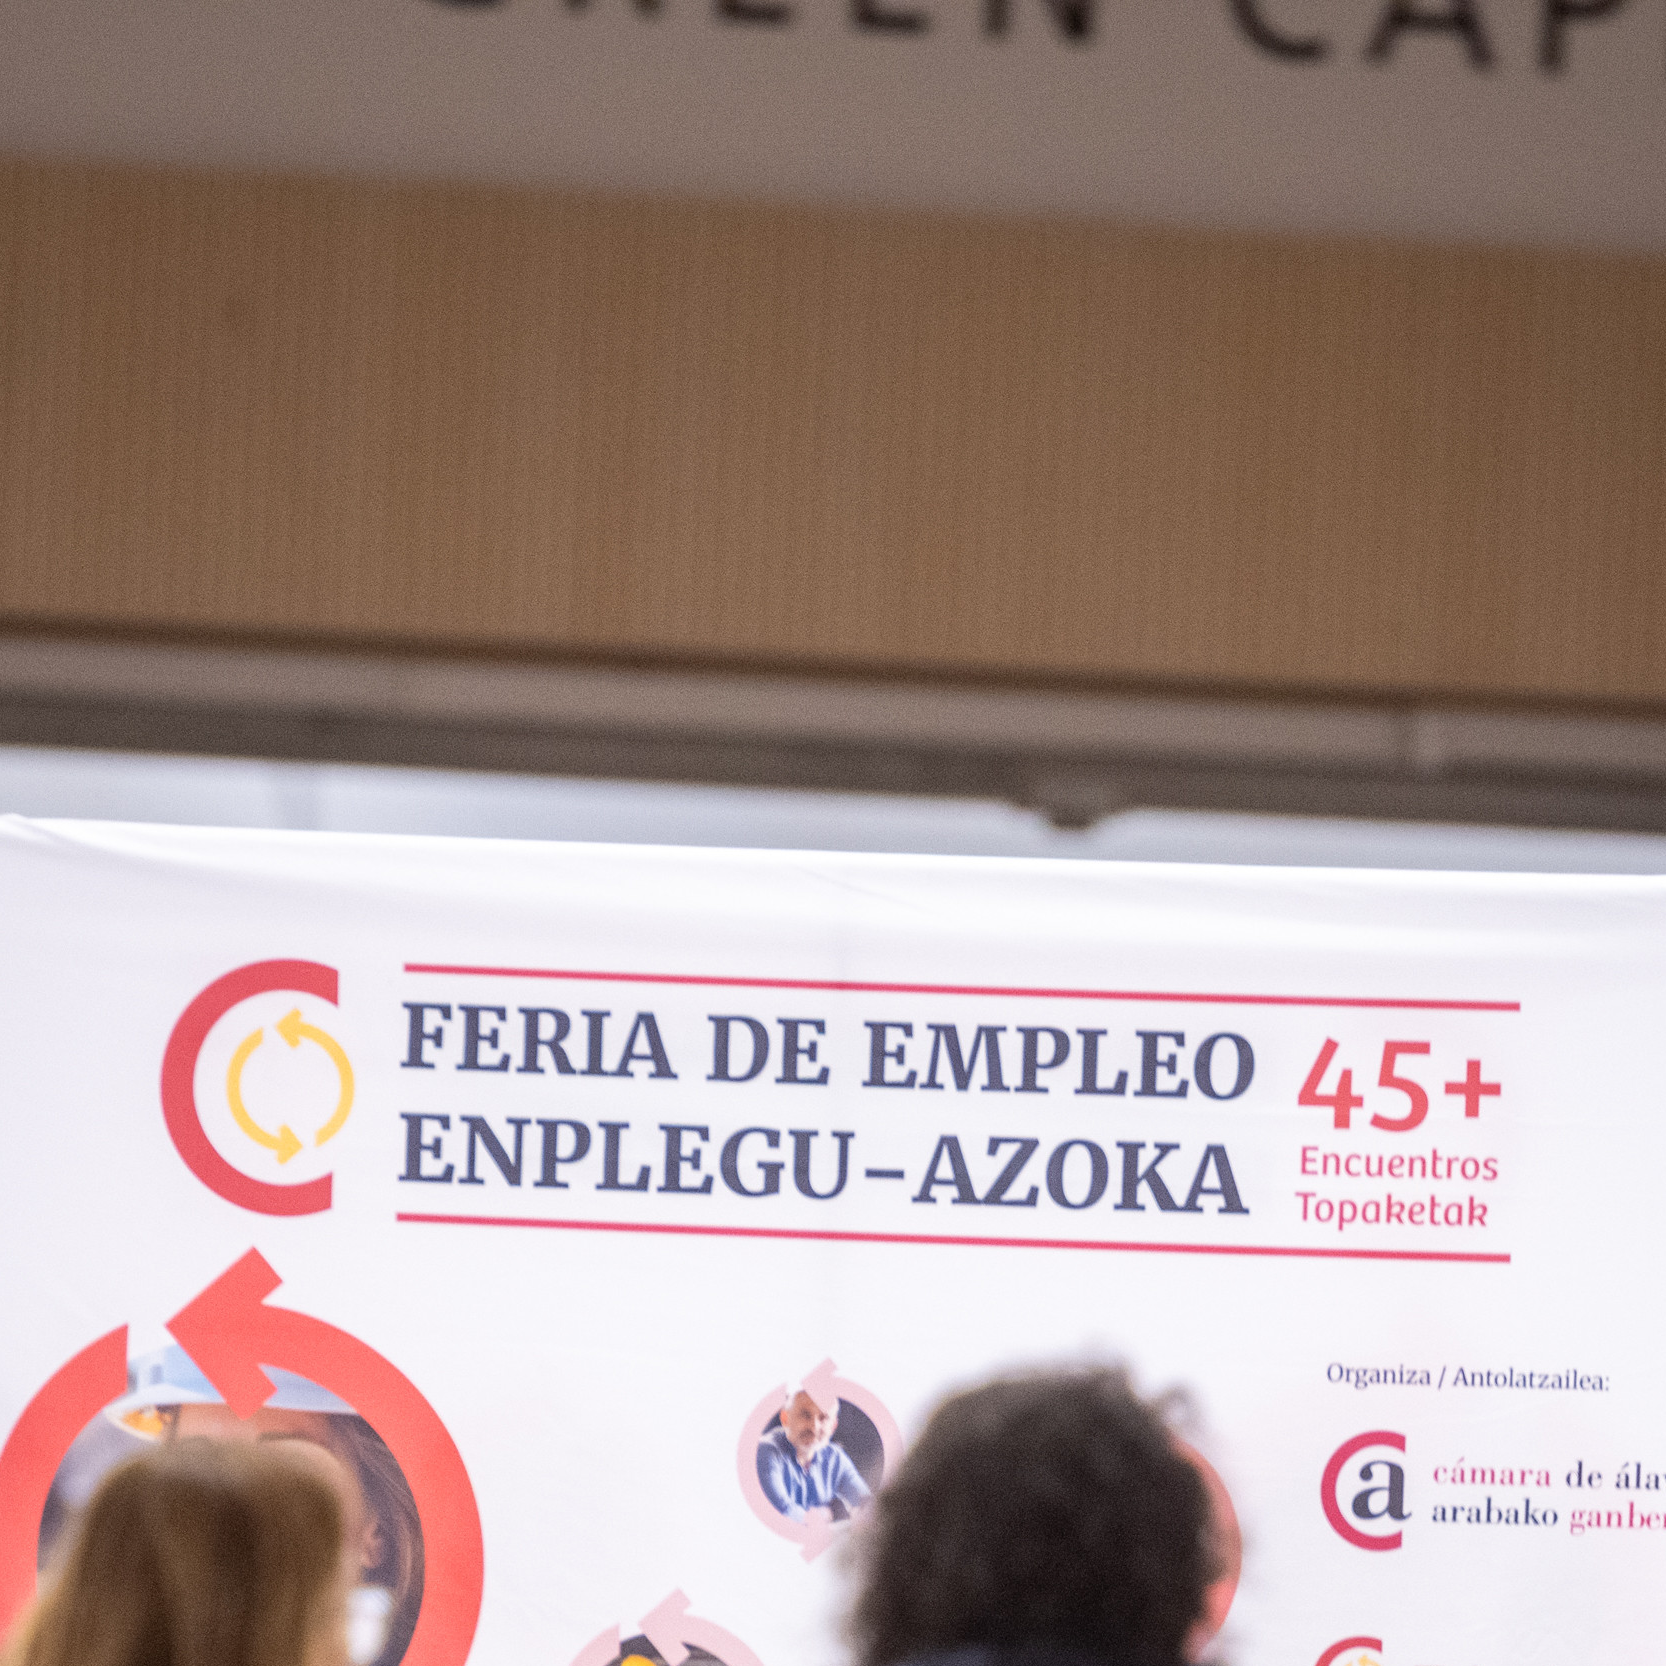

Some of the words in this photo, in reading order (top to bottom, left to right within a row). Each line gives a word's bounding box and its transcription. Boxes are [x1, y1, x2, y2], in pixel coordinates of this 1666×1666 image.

[399, 1001, 679, 1081] FERIA
[706, 1014, 831, 1087] DE
[861, 1020, 1256, 1101] EMPLEO
[1296, 1035, 1503, 1133] 45+
[1299, 1145, 1499, 1182] Encuentros
[1293, 1191, 1489, 1233] Topaketak
[1326, 1363, 1432, 1391] Organiza
[1452, 1366, 1610, 1392] Antolatzailea:
[1432, 1456, 1551, 1488] cámara
[1565, 1460, 1603, 1489] de
[1431, 1496, 1559, 1527] arabako
